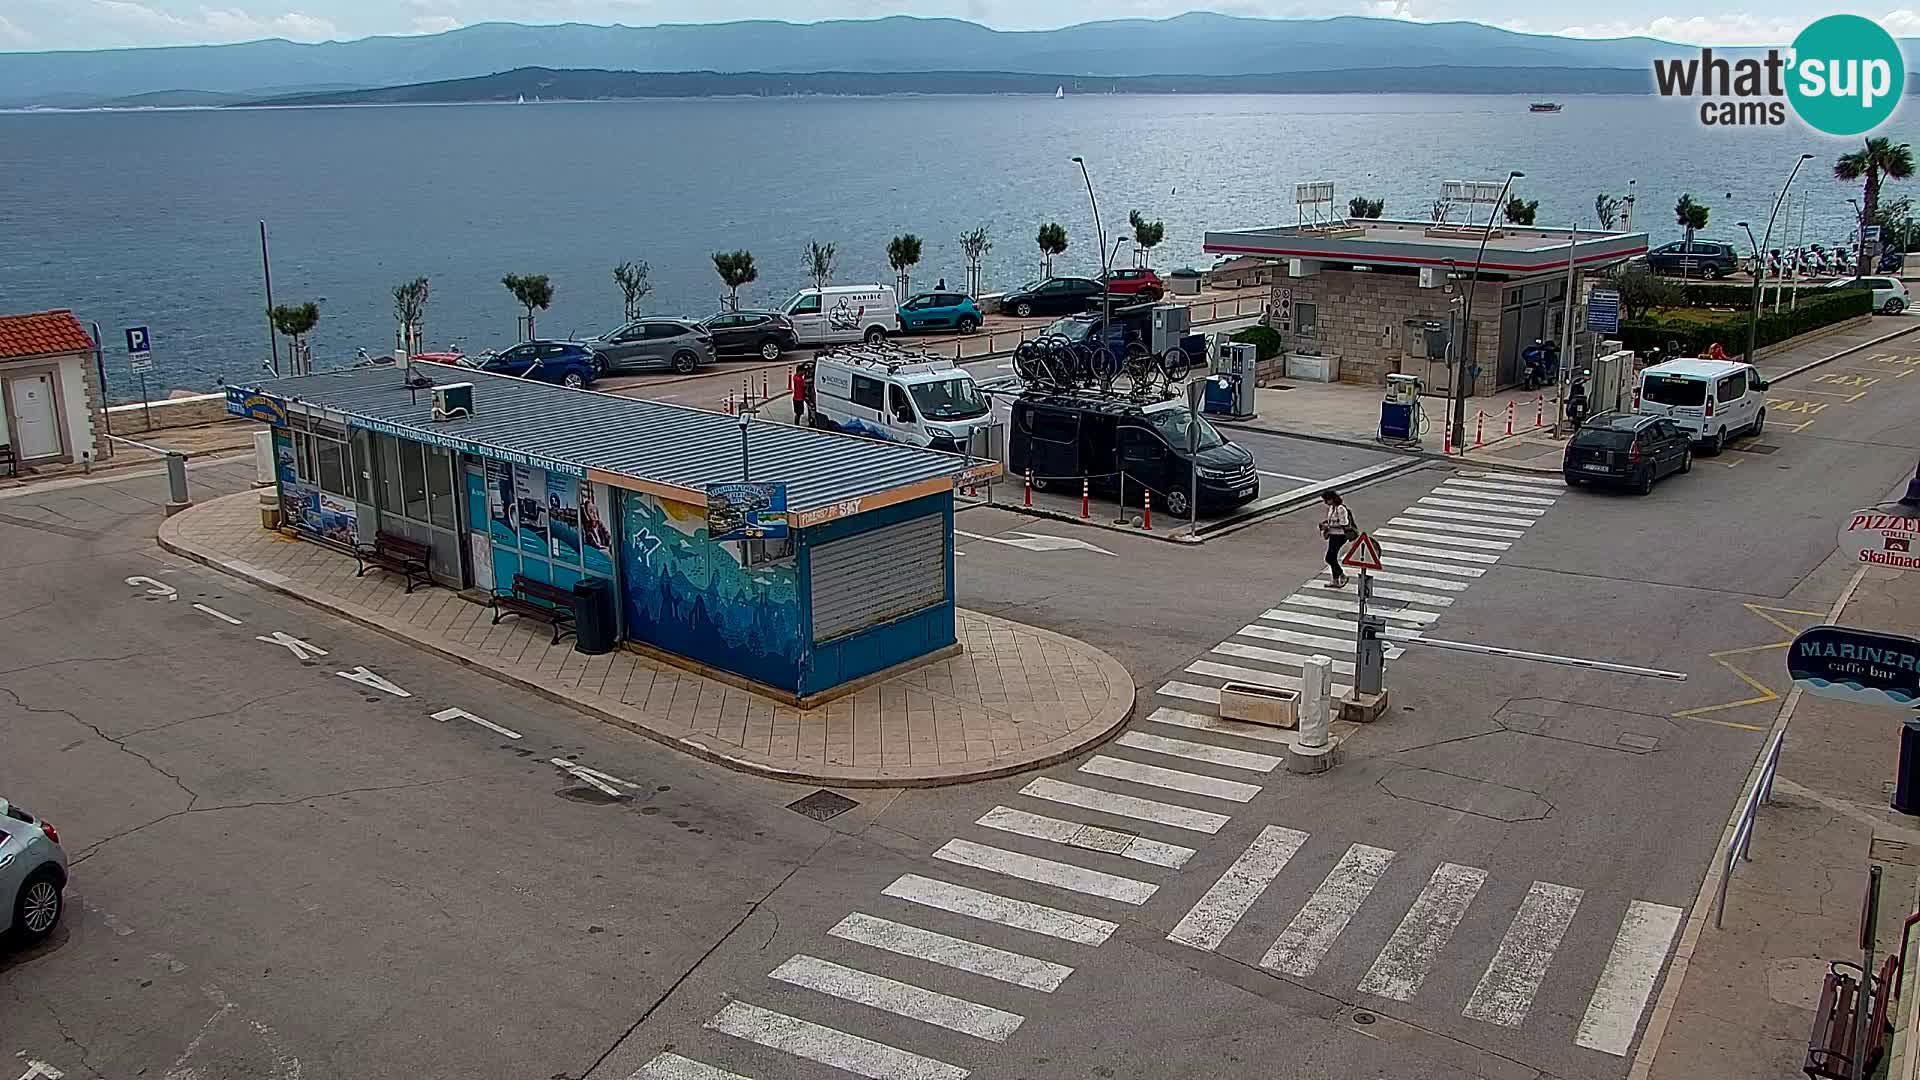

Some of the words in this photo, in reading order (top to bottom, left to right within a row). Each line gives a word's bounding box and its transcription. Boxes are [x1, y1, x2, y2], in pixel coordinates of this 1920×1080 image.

[131, 331, 143, 349] P
[1814, 374, 1880, 388] TAXI
[396, 426, 437, 444] AUTOBUSNA
[437, 436, 469, 452] POSTAJA
[479, 445, 494, 457] BUS
[495, 449, 527, 465] STATION
[528, 456, 555, 471] TICKET
[556, 462, 583, 477] OFFICE
[1881, 530, 1916, 540] GRILL
[1828, 662, 1865, 673] caffe
[1870, 665, 1896, 679] bar
